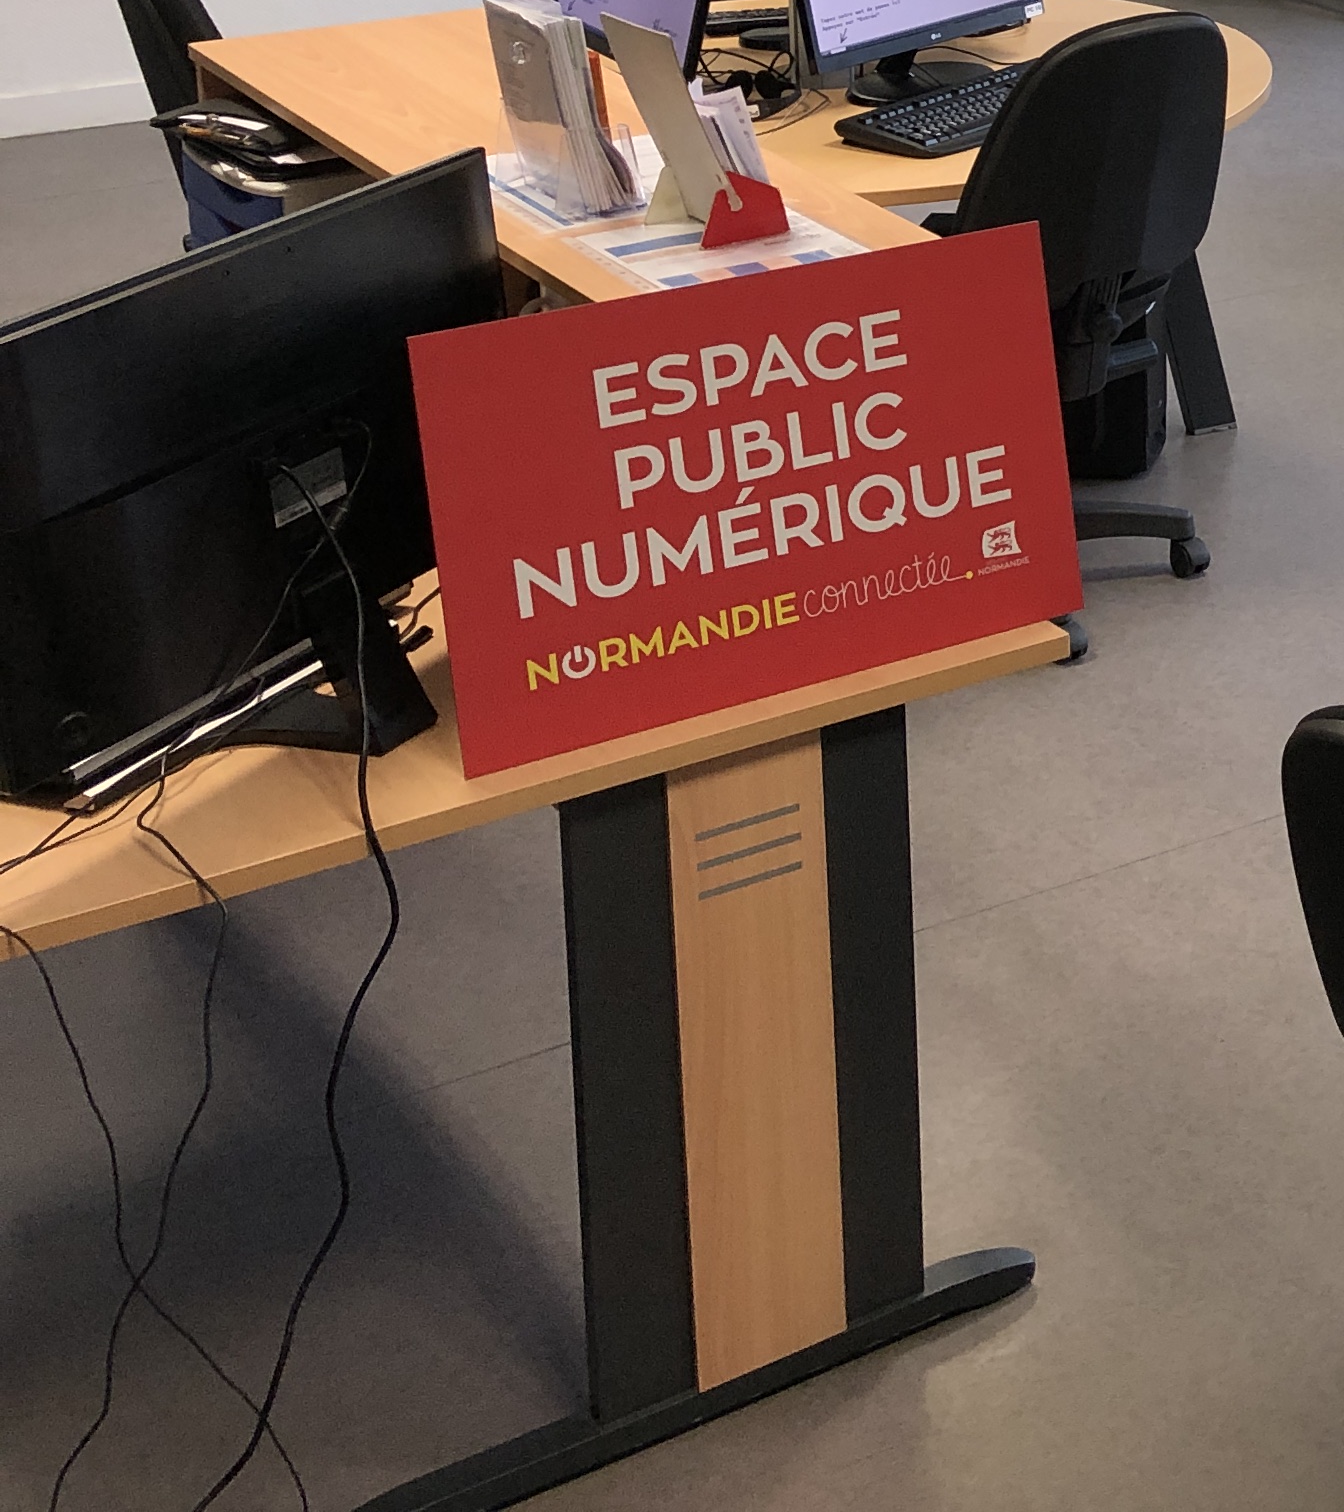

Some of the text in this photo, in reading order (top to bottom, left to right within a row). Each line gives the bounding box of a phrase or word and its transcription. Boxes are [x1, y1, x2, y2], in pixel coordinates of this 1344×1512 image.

[592, 309, 908, 429] ESPACE
[613, 392, 907, 509] PUBLIC
[512, 444, 1012, 620] NUMÉRIQUE
[977, 555, 1031, 577] NORMANDIE
[525, 551, 966, 691] NORMANDIE connectée
